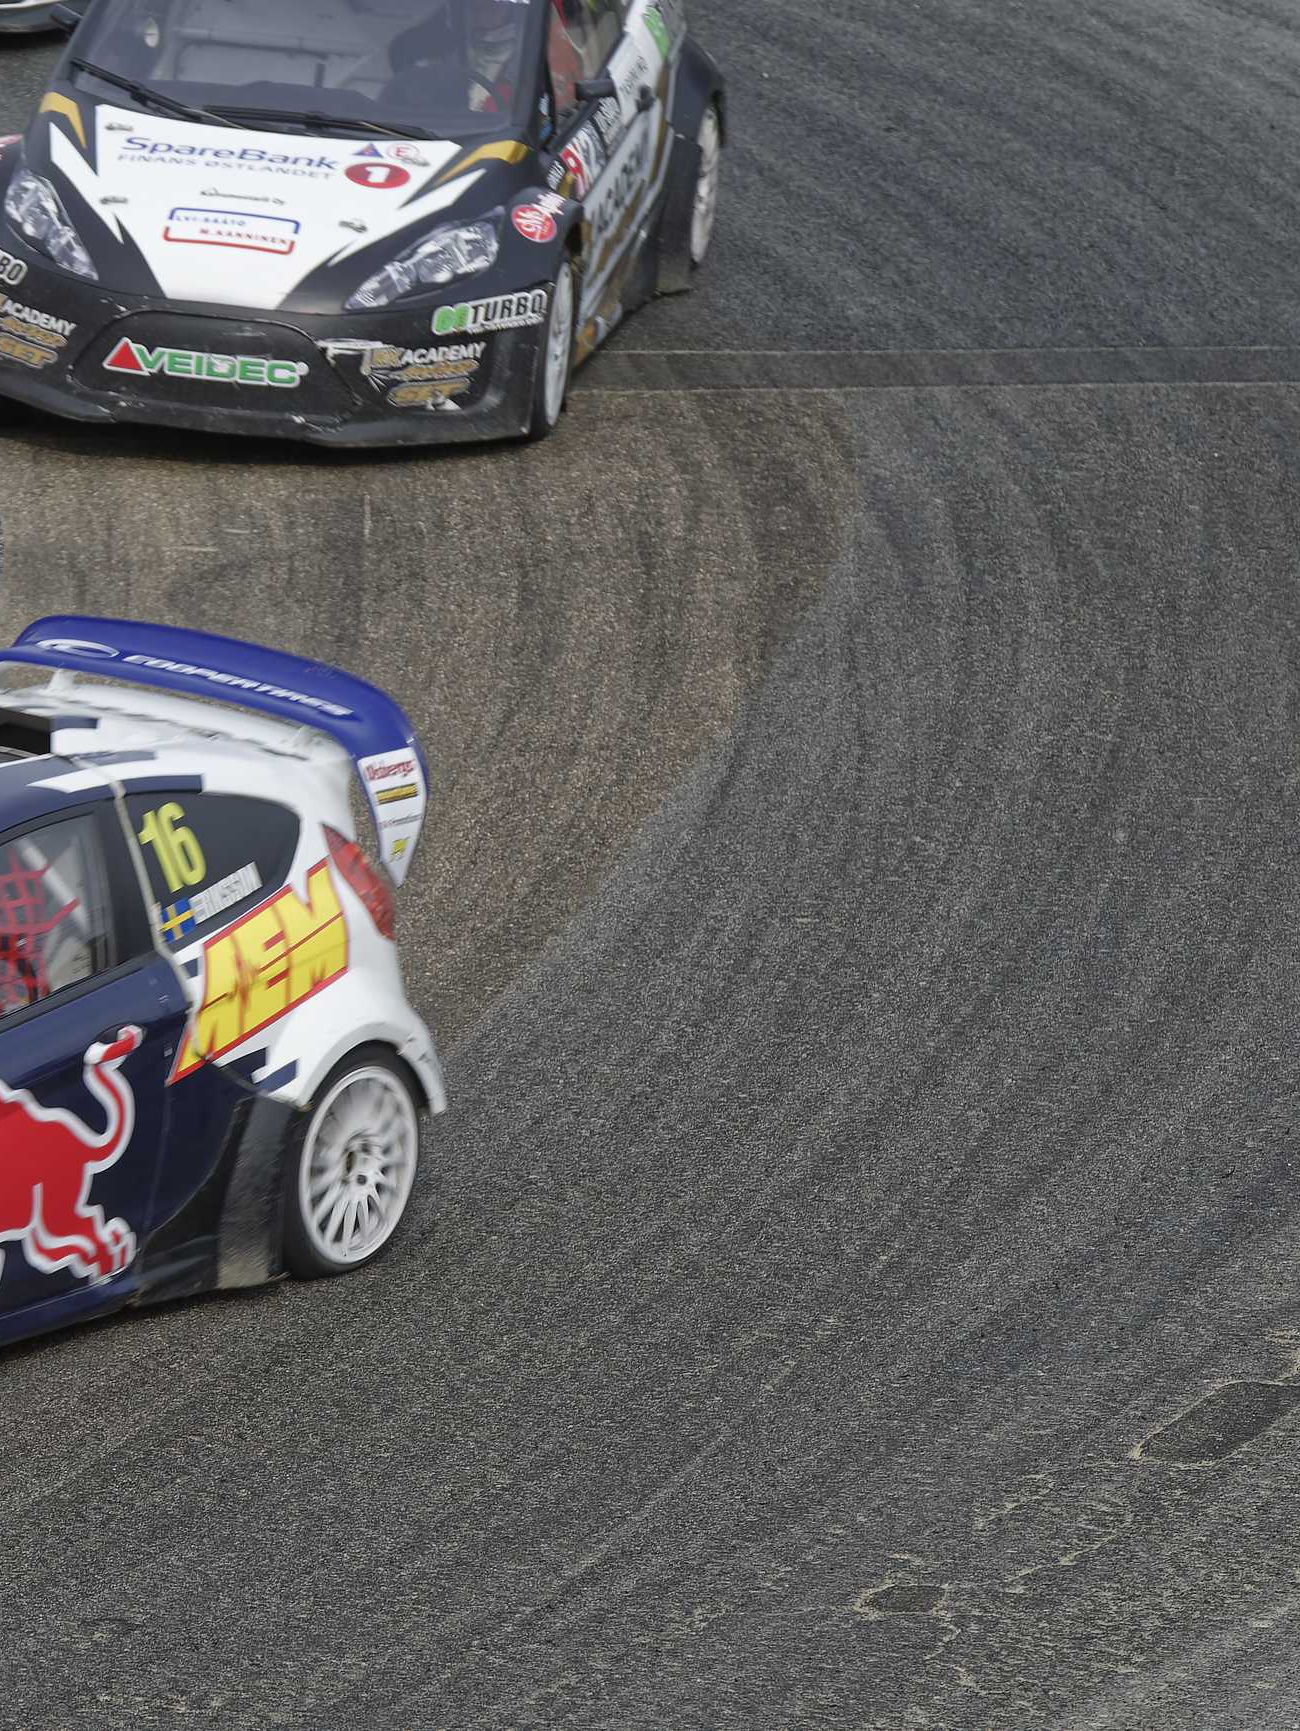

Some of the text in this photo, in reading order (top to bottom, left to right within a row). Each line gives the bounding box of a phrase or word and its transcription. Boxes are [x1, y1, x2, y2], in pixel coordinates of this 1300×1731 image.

[118, 154, 197, 166] FINANS
[123, 136, 338, 170] SpareBank
[2, 299, 77, 337] ACADEMY
[469, 292, 546, 325] TURBO
[133, 347, 300, 388] VEIDEC
[397, 342, 487, 366] ACADEMY
[138, 801, 207, 893] 16
[166, 857, 349, 1087] AEM
